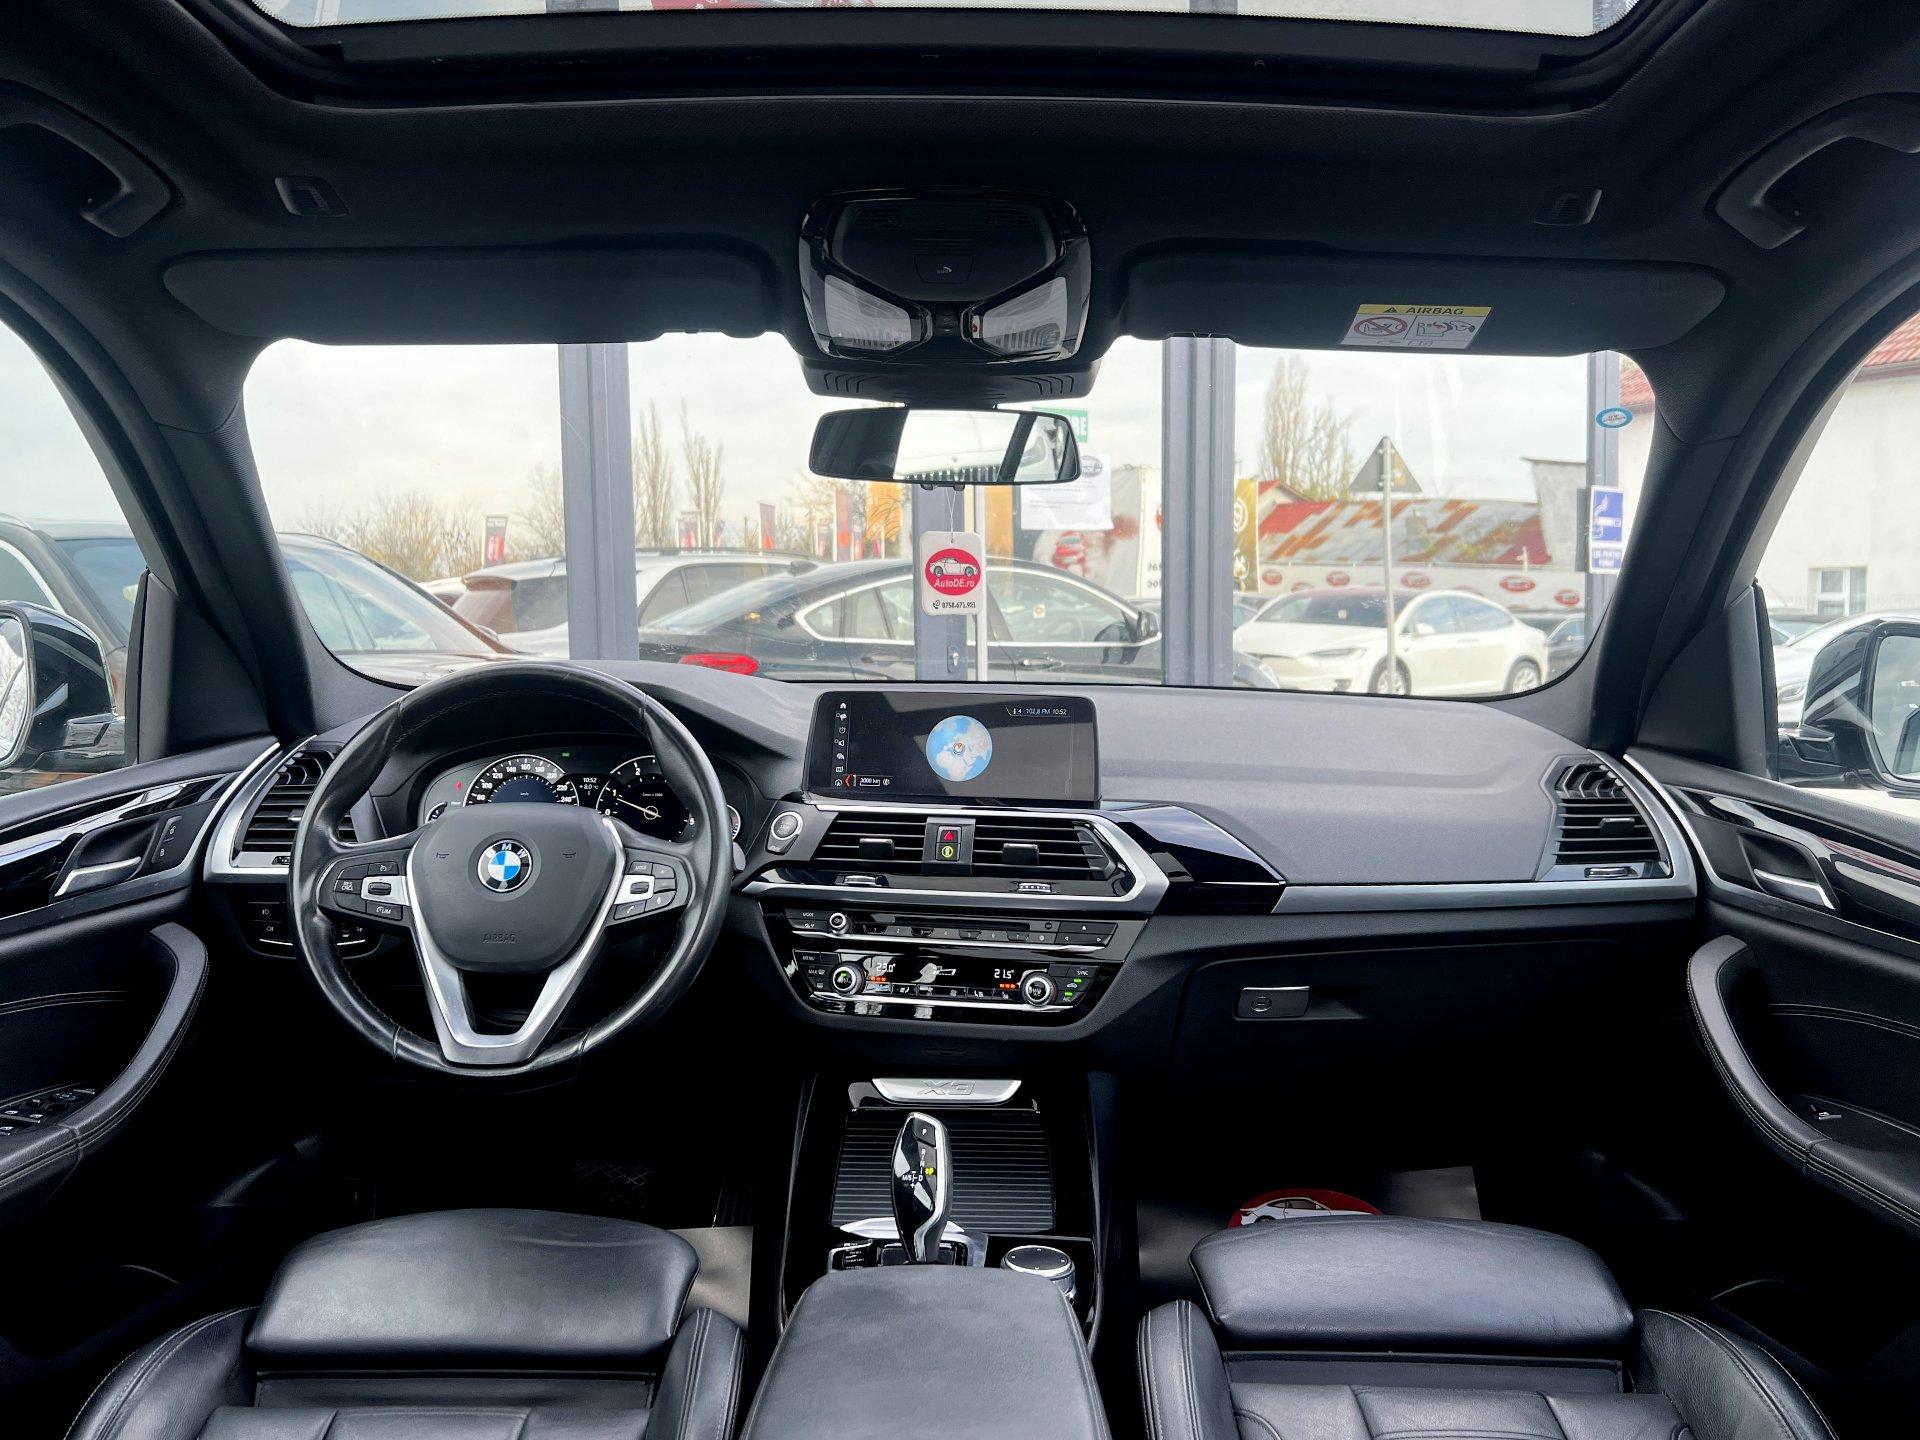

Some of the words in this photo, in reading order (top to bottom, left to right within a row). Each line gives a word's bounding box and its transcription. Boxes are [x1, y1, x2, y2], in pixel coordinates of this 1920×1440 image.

[1405, 306, 1464, 315] AIRBAG
[934, 578, 975, 588] AutoDE.ro
[520, 763, 531, 771] 160
[635, 767, 641, 776] 2
[492, 772, 503, 780] 120
[546, 772, 558, 780] 200
[481, 782, 493, 790] 100
[557, 784, 568, 792] 220
[476, 793, 486, 801] 80
[612, 789, 617, 797] 1
[605, 808, 611, 816] 0
[484, 843, 528, 859] BMW
[482, 932, 517, 944] AIRBAG
[918, 1080, 976, 1095] X3
[921, 1128, 927, 1136] P
